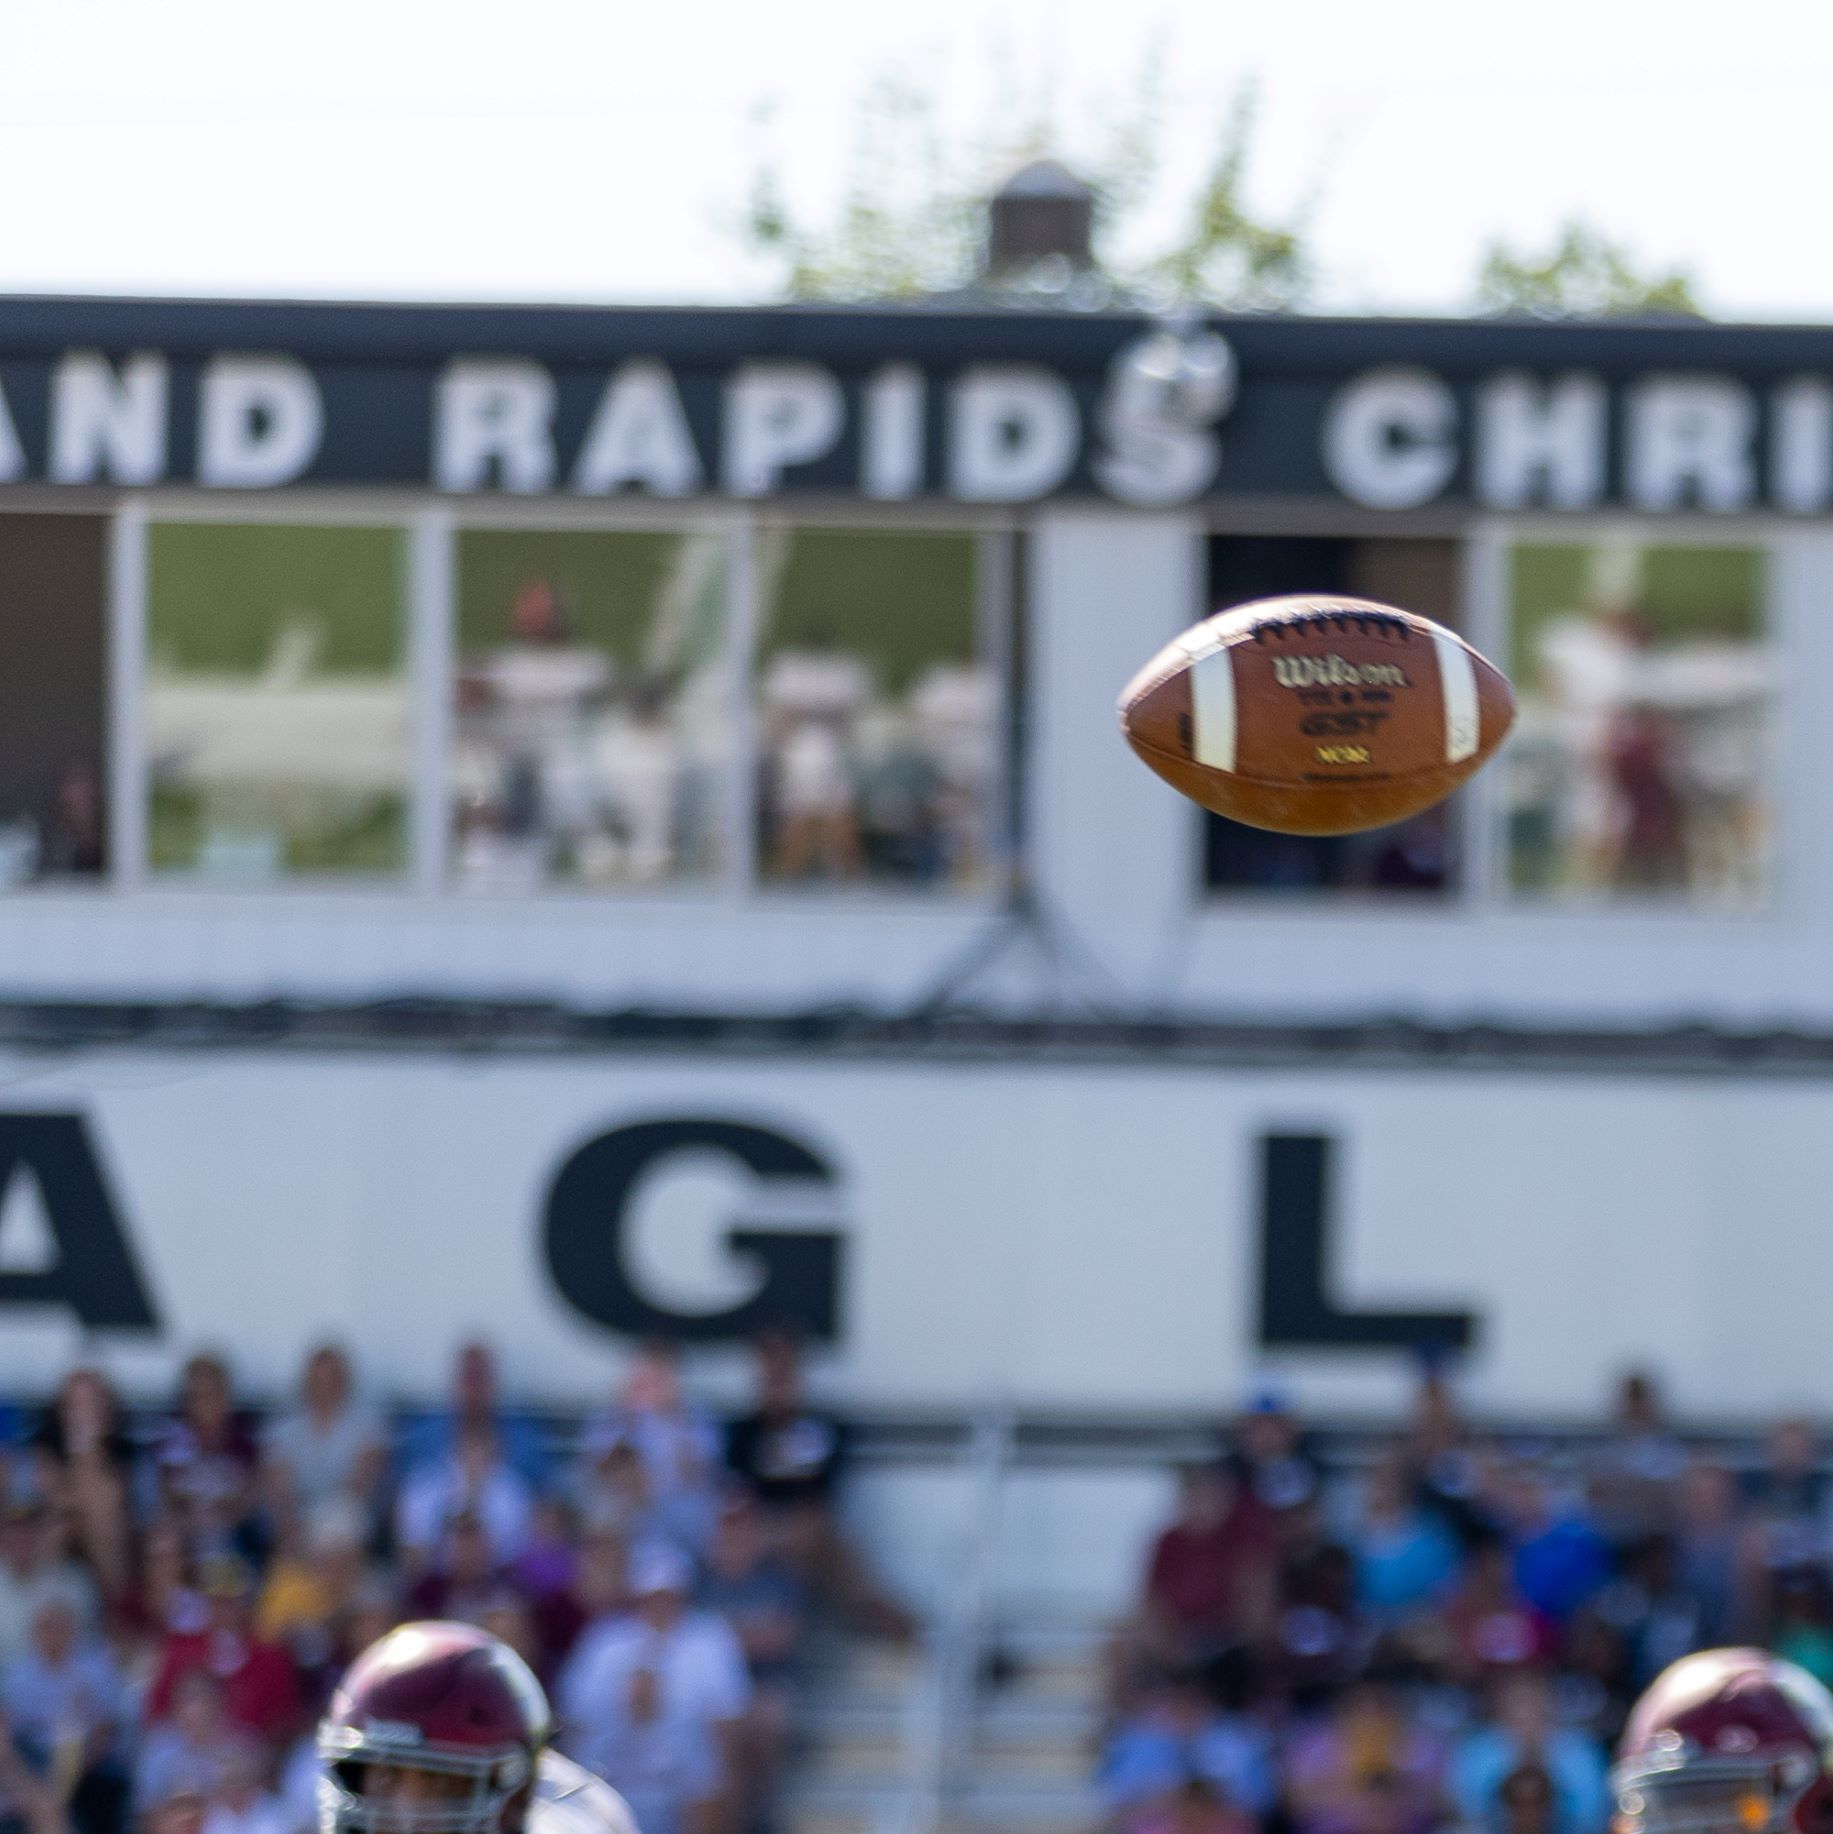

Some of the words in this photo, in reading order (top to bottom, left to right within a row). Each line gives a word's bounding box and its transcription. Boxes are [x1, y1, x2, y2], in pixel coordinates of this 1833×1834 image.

[0, 350, 323, 488] ND
[431, 354, 1222, 503] RAPIDS
[1271, 653, 1409, 688] Wilson
